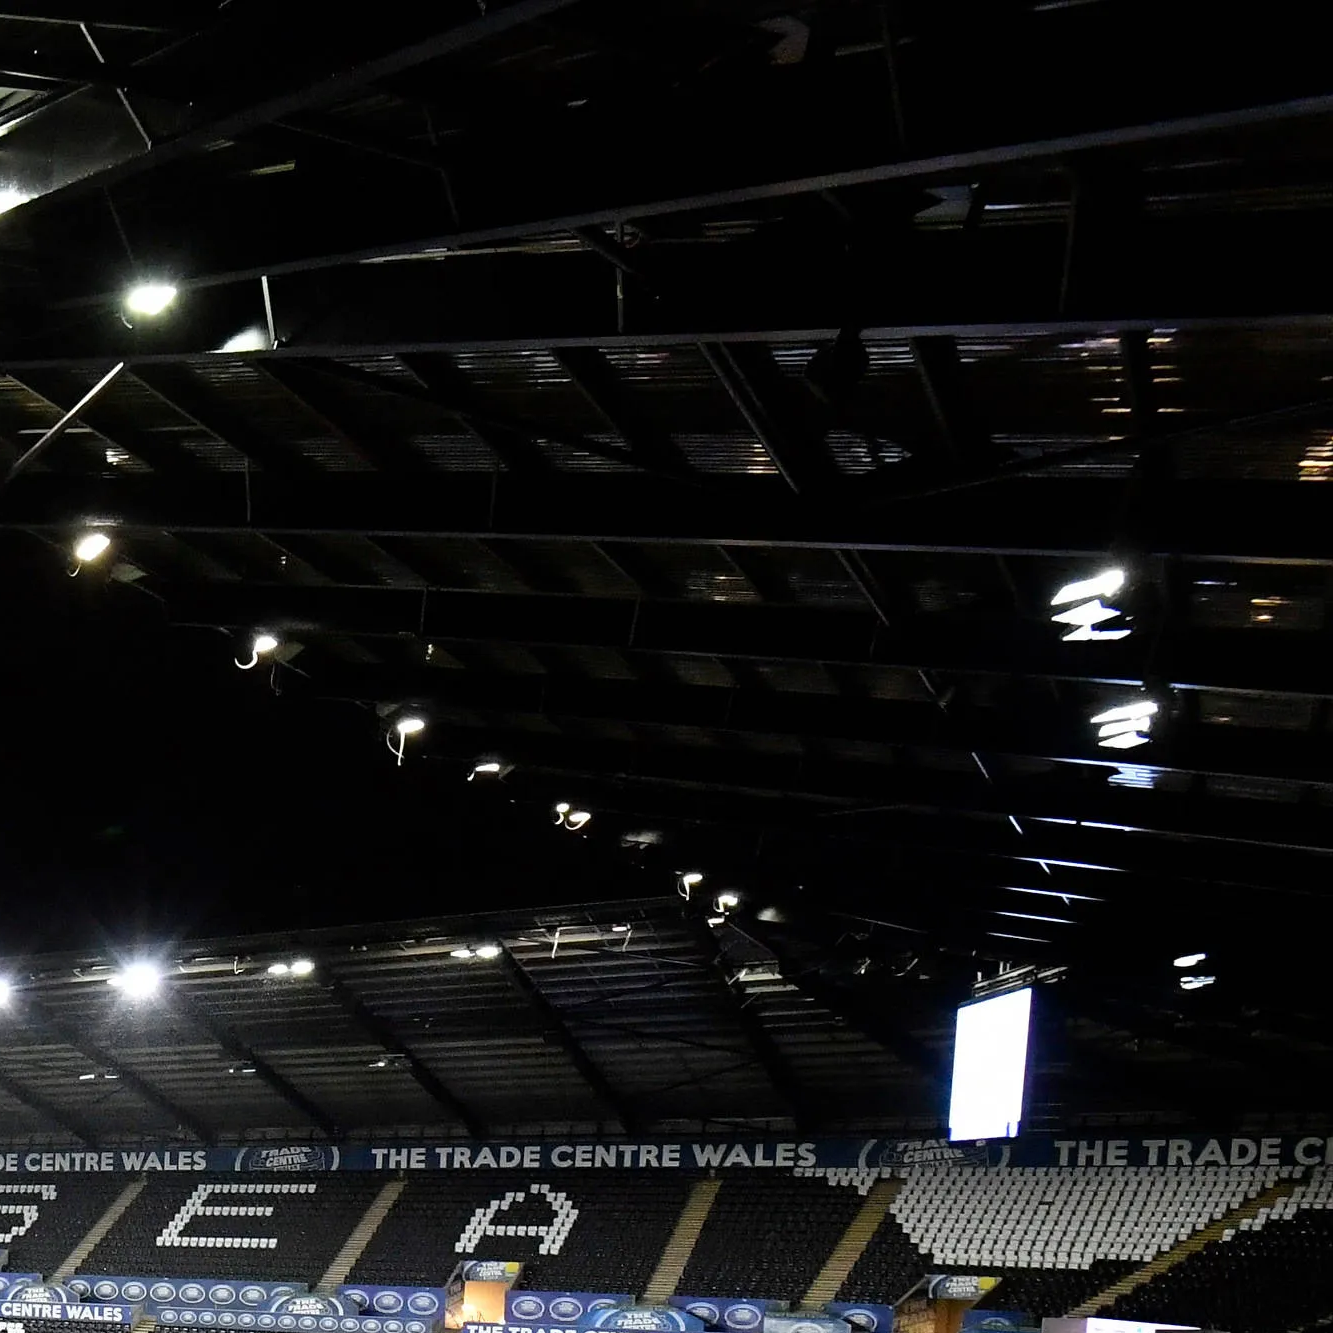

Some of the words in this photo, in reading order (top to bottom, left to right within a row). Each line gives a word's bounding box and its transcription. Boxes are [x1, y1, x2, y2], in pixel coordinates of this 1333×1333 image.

[24, 1151, 114, 1172] CENTRE
[121, 1151, 207, 1171] WALES
[265, 1154, 307, 1167] CENTRE
[371, 1148, 426, 1169] THE
[435, 1146, 541, 1169] TRADE
[551, 1144, 681, 1168] CENTRE
[693, 1142, 817, 1168] WALES
[902, 1147, 965, 1165] CENTRE
[1054, 1140, 1130, 1166] THE
[1141, 1138, 1282, 1166] TRADE
[1, 1302, 62, 1319] CENTRE
[66, 1305, 123, 1322] WALES
